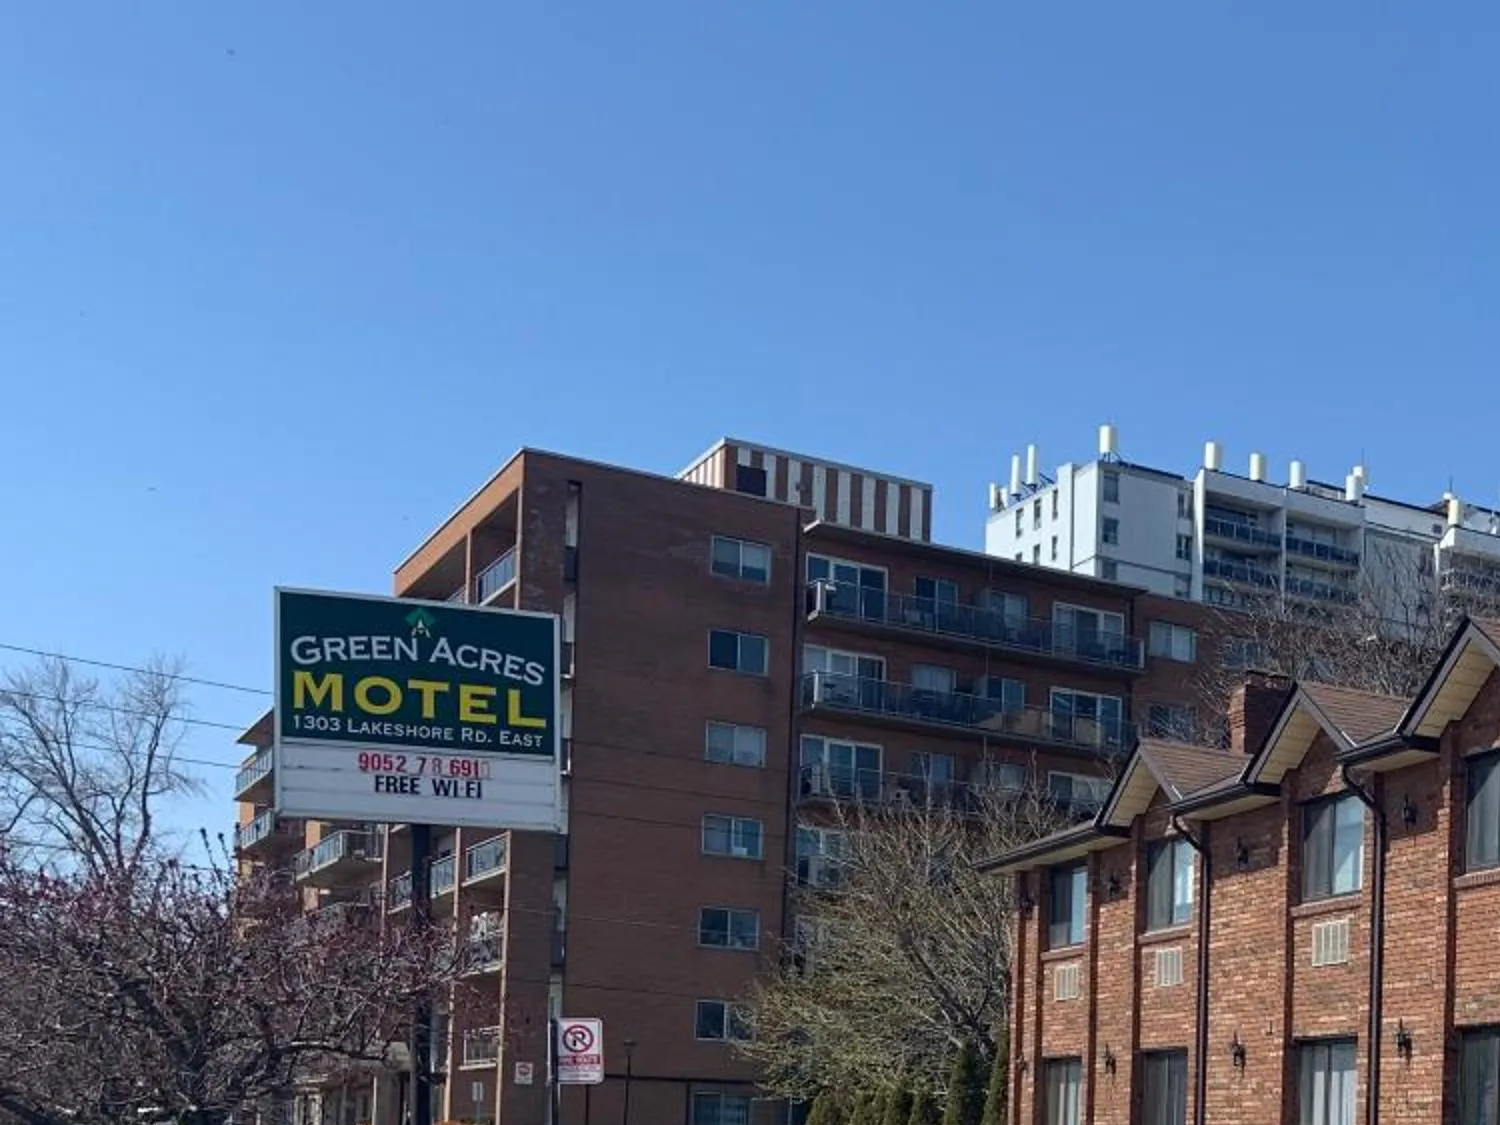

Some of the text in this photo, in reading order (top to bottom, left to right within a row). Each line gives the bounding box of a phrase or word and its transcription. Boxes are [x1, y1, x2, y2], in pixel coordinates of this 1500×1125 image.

[291, 635, 545, 686] GREEN ACRES
[293, 671, 546, 728] MOTEL
[294, 715, 543, 747] 1303 LAKESHORE RD. EAST
[374, 775, 421, 794] FREE
